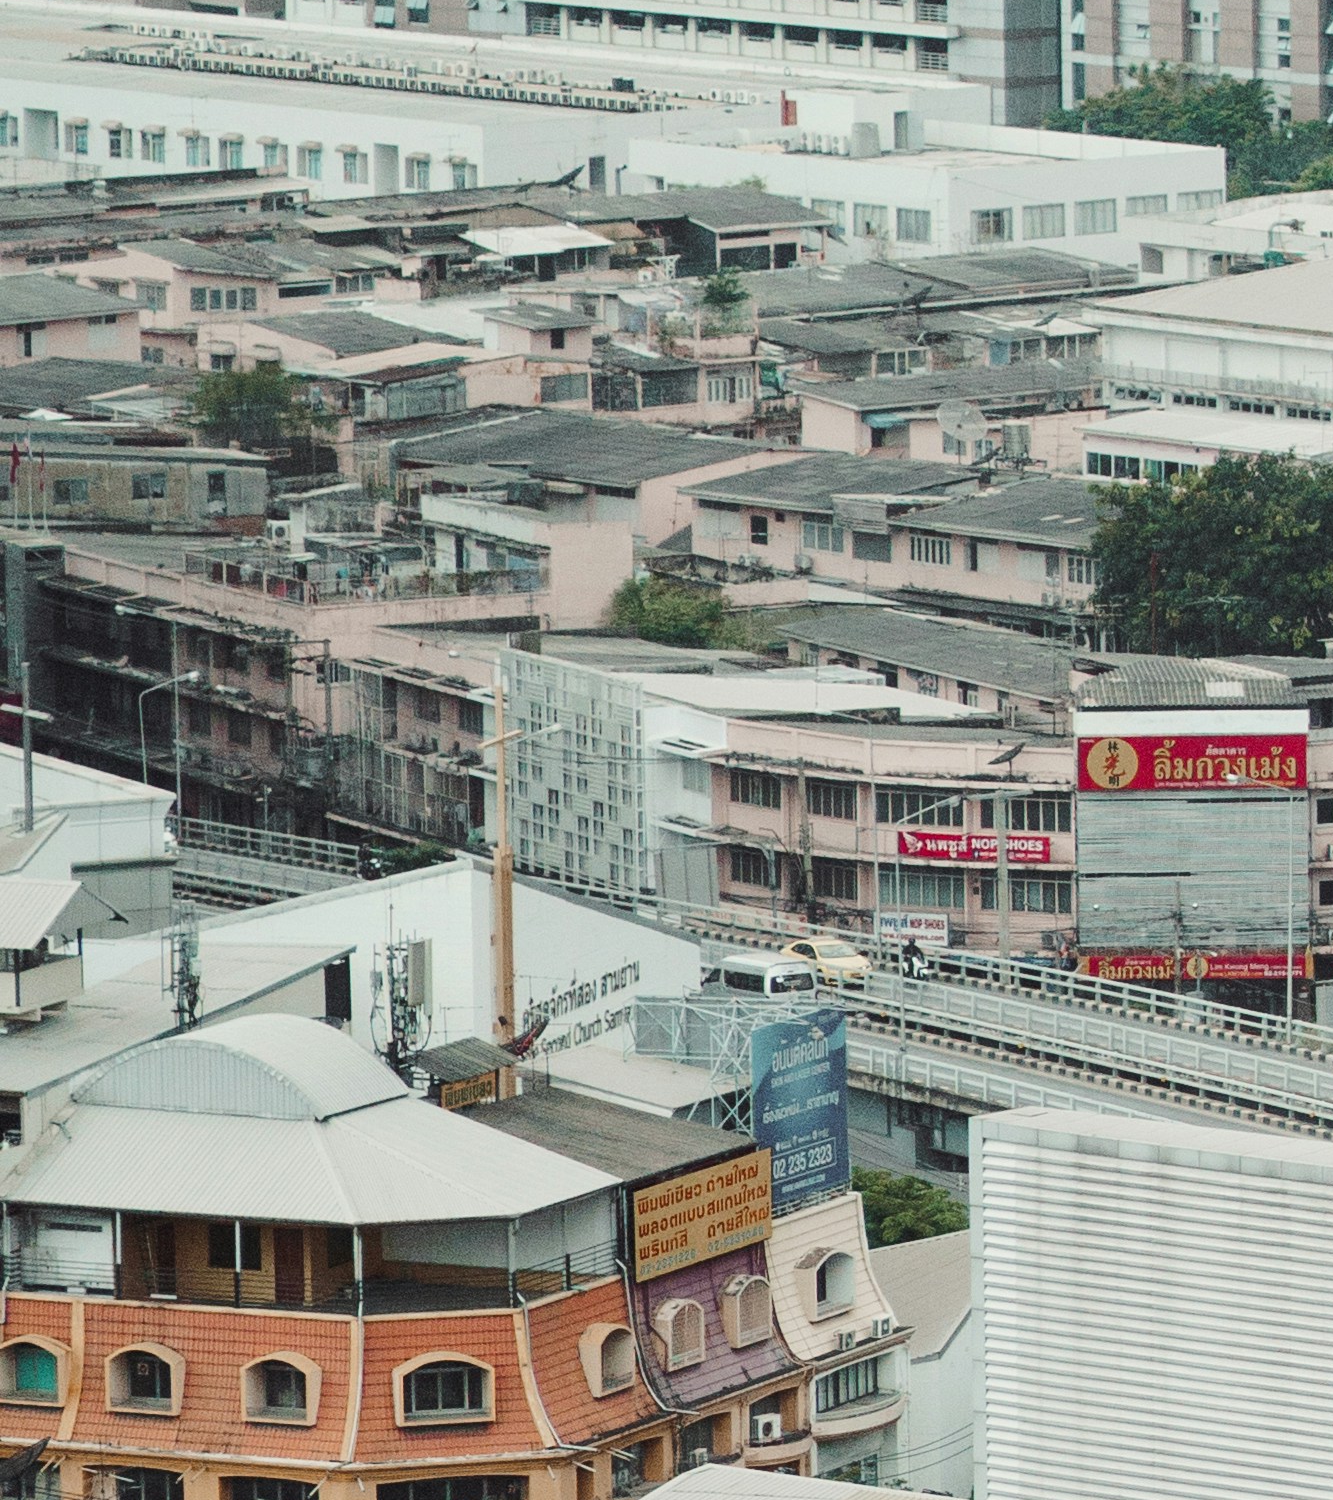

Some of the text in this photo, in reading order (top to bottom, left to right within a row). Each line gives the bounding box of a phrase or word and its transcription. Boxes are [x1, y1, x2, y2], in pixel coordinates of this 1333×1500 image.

[971, 838, 997, 850] NOP
[574, 1014, 603, 1046] Church
[706, 1160, 759, 1193] ถ่ายใหญ่
[773, 1144, 833, 1179] 02 235 2323
